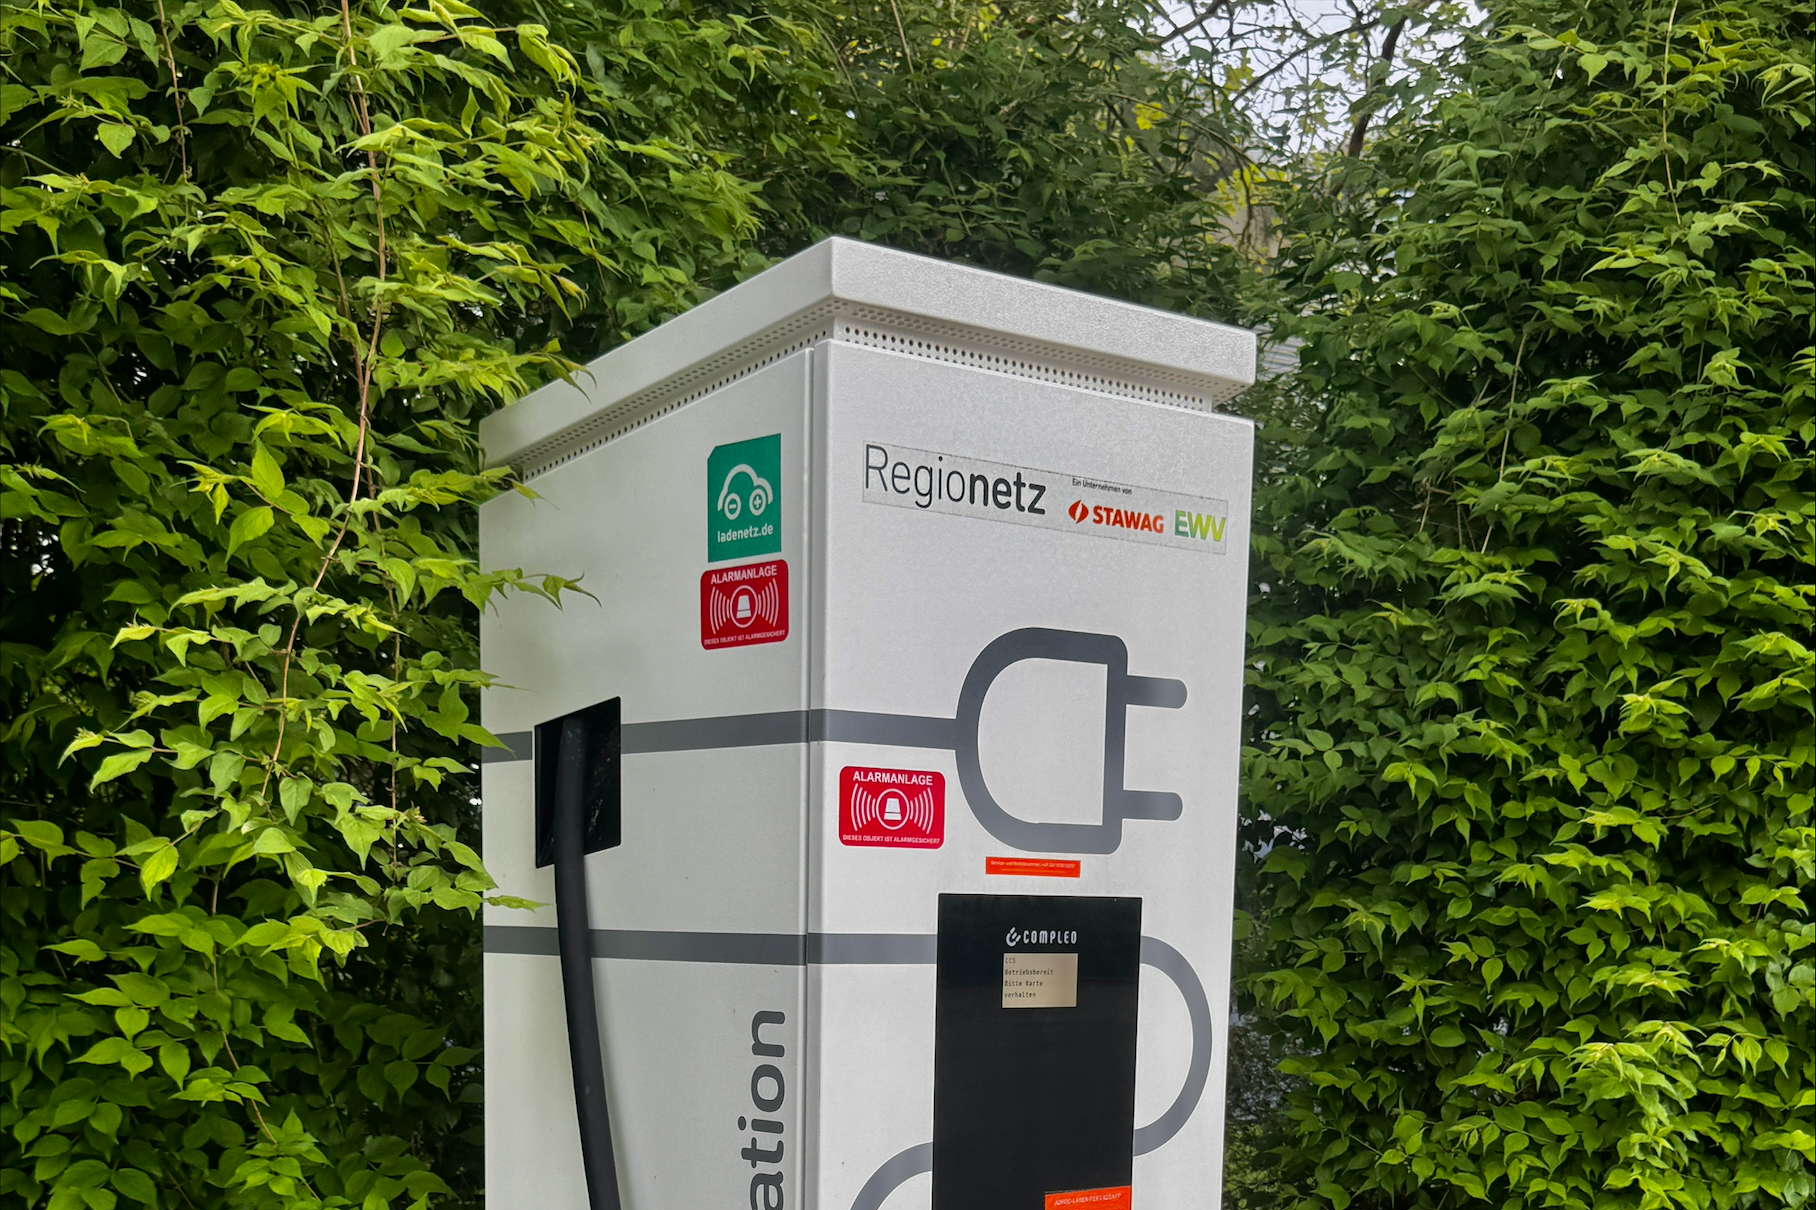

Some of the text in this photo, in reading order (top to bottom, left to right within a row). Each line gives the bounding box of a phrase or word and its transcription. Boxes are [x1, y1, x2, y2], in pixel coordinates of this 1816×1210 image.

[864, 443, 1046, 515] Regionetz
[1072, 477, 1132, 496] Ein Unternehmen von
[1092, 504, 1226, 543] STAWAG EWV
[717, 523, 774, 543] ladenetz.de
[711, 564, 778, 585] ALARMANLAGE
[703, 637, 720, 646] DIESES
[720, 635, 737, 643] OBJEKT
[745, 629, 786, 640] ALARMGESICHERT
[852, 770, 934, 786] ALARMANLAGE
[842, 834, 941, 845] DIESES OBJEKT IST ALARMGESICHERT
[1023, 929, 1077, 944] COMPLEO
[1004, 968, 1054, 976] Betriebsbereit
